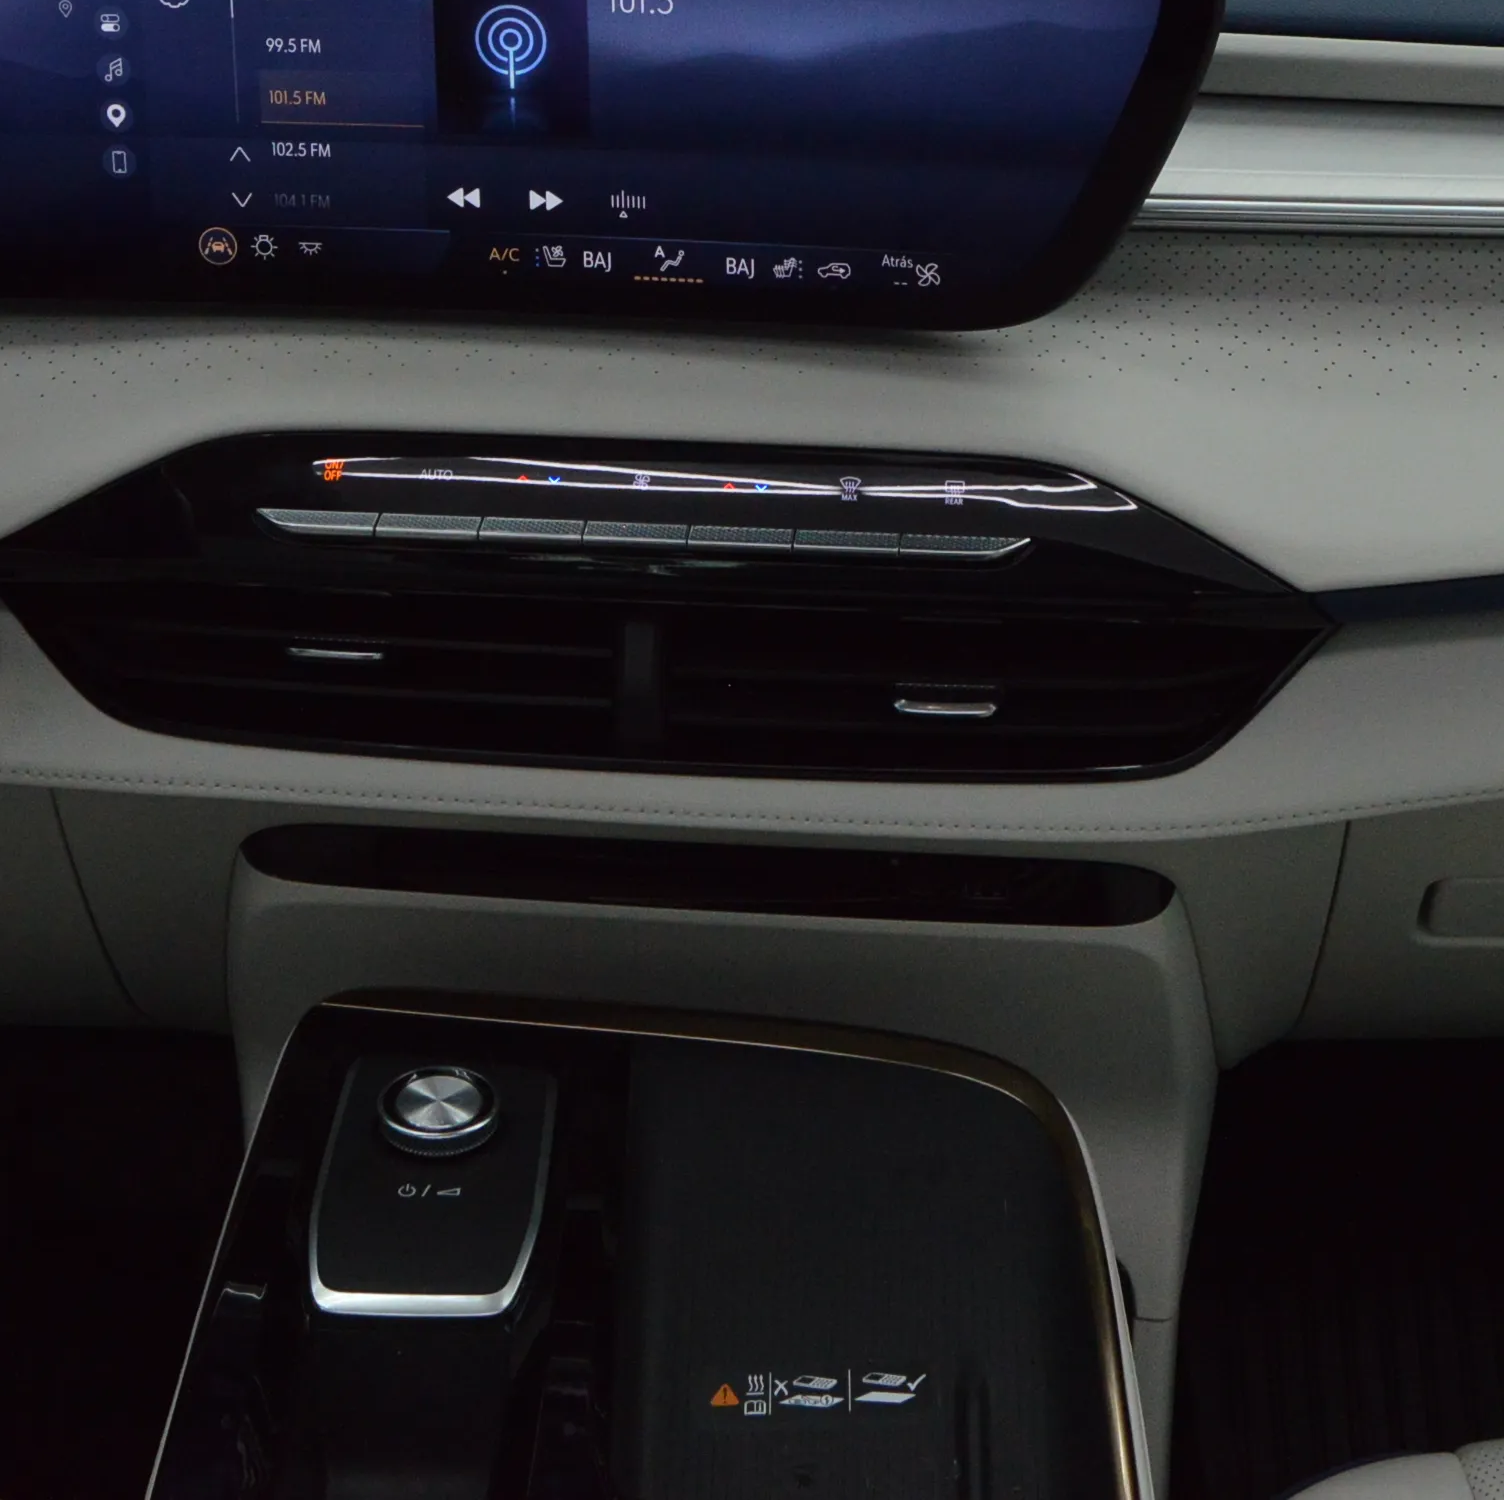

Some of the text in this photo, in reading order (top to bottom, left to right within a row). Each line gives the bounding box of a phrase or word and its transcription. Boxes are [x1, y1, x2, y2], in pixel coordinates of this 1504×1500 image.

[265, 37, 321, 54] 99.5 FM
[269, 89, 326, 106] 101.5 FM
[271, 141, 332, 158] 102.5 FM
[274, 192, 331, 209] 104.1 FM
[489, 246, 520, 263] A/C
[654, 244, 665, 258] A
[582, 250, 612, 273] BAJ
[725, 257, 755, 280] BAJ
[881, 252, 914, 269] Atrás
[323, 470, 343, 482] OFF
[419, 468, 453, 480] AUTO
[841, 493, 858, 502] MAX
[944, 497, 964, 506] REAR
